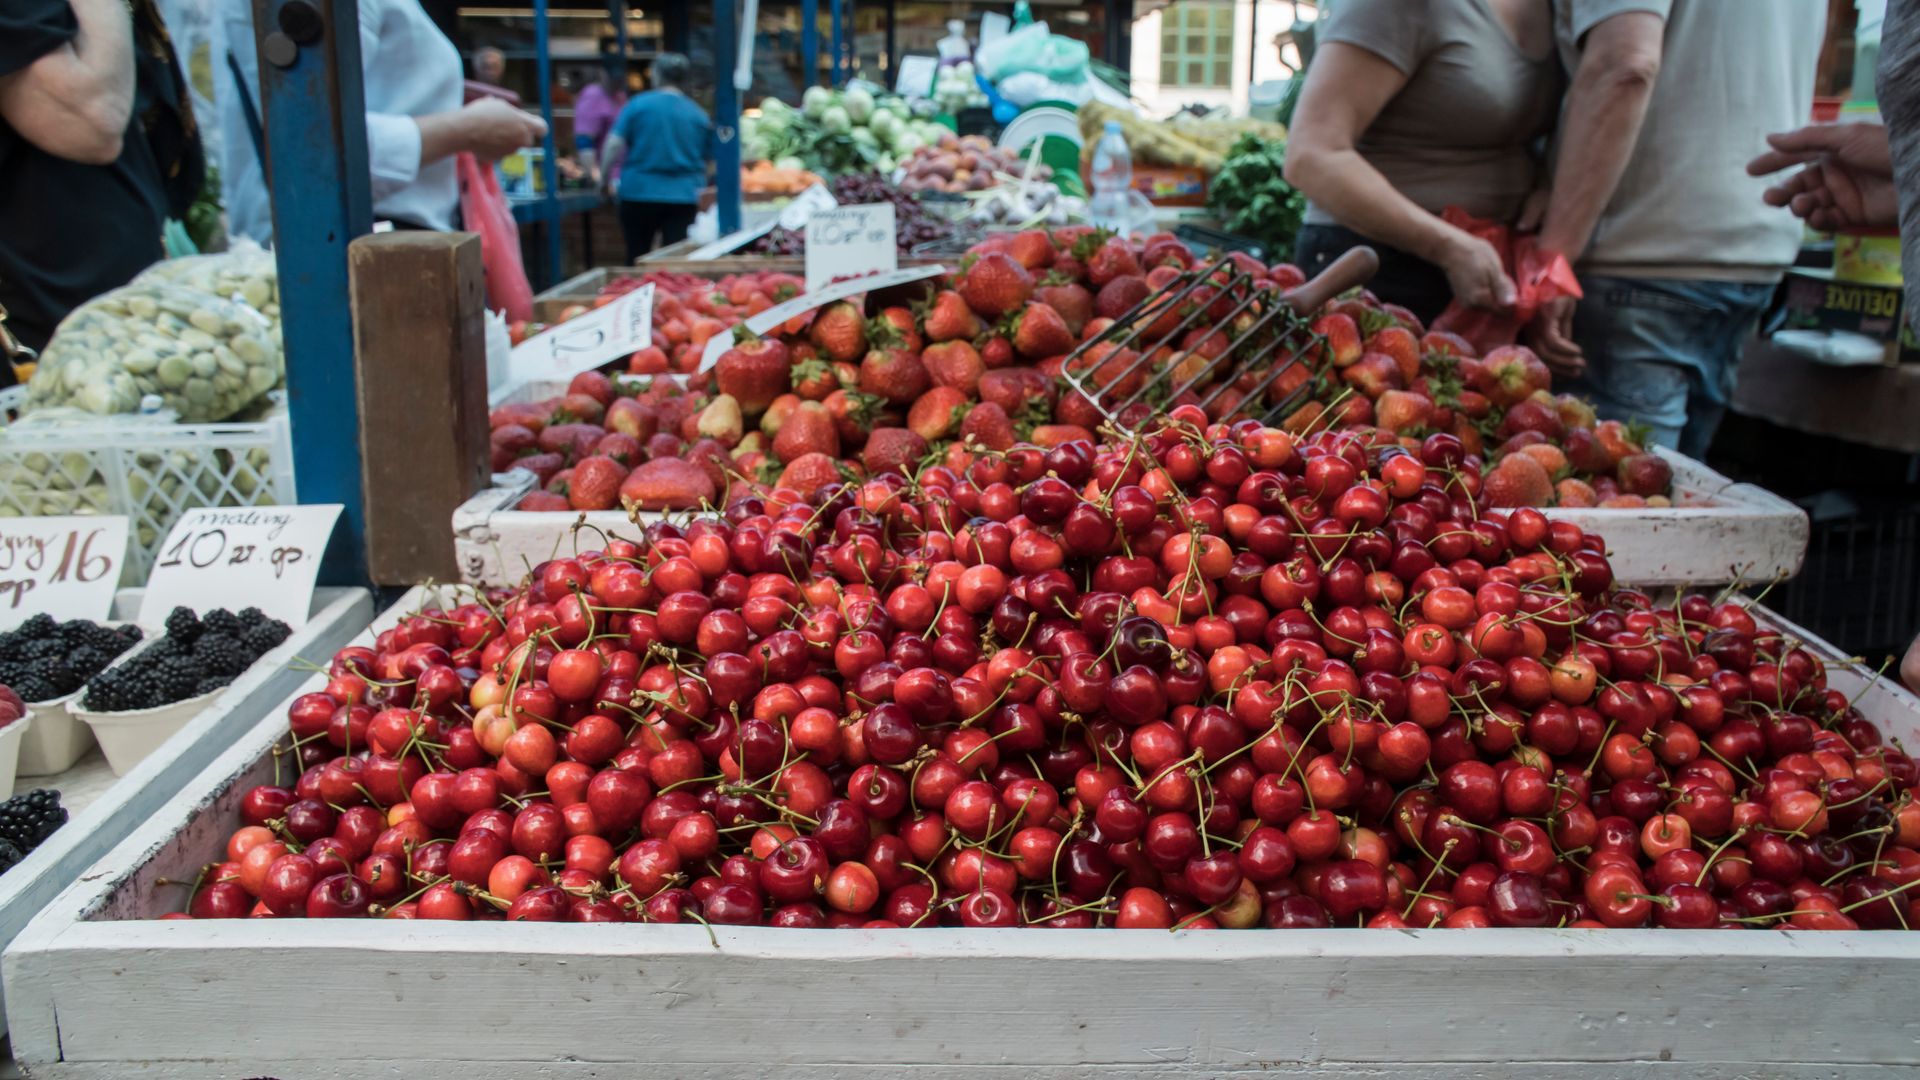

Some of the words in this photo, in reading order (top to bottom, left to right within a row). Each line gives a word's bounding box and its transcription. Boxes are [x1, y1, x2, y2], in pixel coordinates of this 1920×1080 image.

[1824, 284, 1897, 317] DELUXE
[190, 511, 295, 541] maliny
[0, 531, 58, 571] yny
[48, 527, 112, 584] 16
[159, 529, 227, 568] 10
